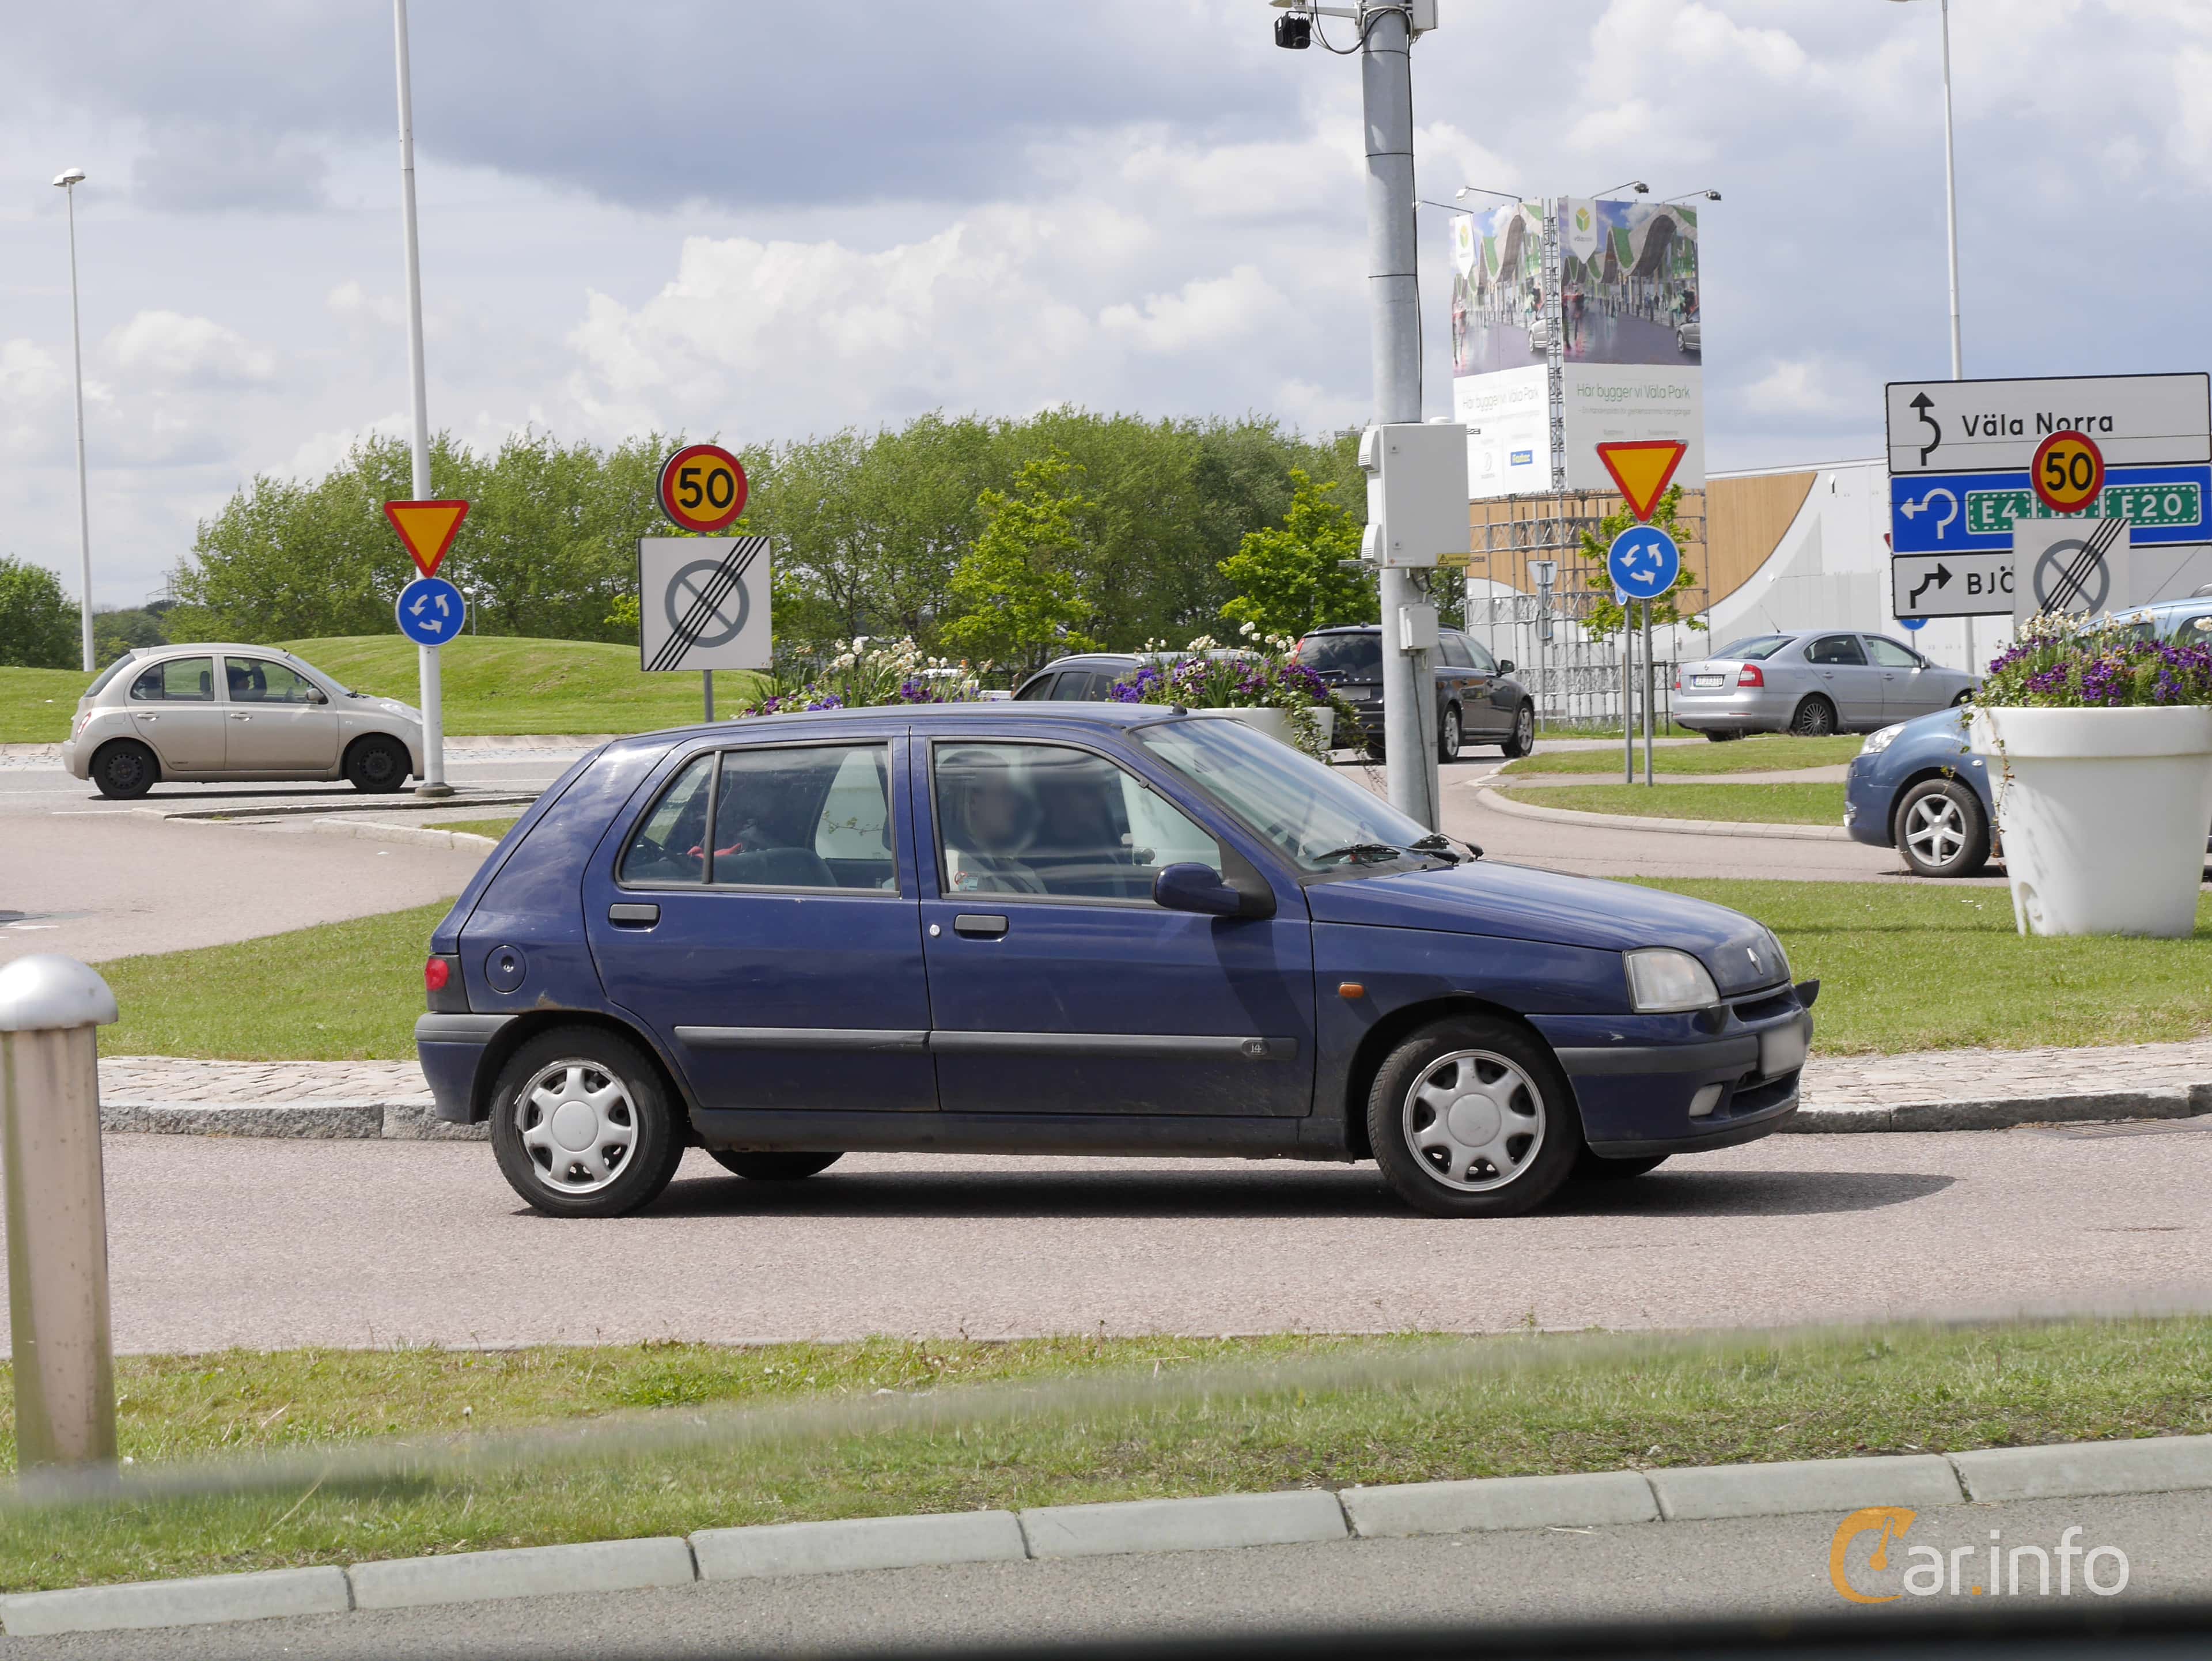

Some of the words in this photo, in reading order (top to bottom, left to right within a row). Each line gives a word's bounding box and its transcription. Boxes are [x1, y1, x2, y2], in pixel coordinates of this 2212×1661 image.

[1597, 383, 1633, 402] bygger
[1634, 384, 1642, 398] vi
[1668, 385, 1691, 399] Park
[1961, 414, 2024, 437] Väla
[2036, 412, 2113, 435] Norra
[2046, 452, 2093, 491] 50
[679, 468, 734, 509] 50
[1981, 500, 2019, 523] E4
[2122, 493, 2183, 518] E20
[1967, 566, 2014, 595] BJÖ
